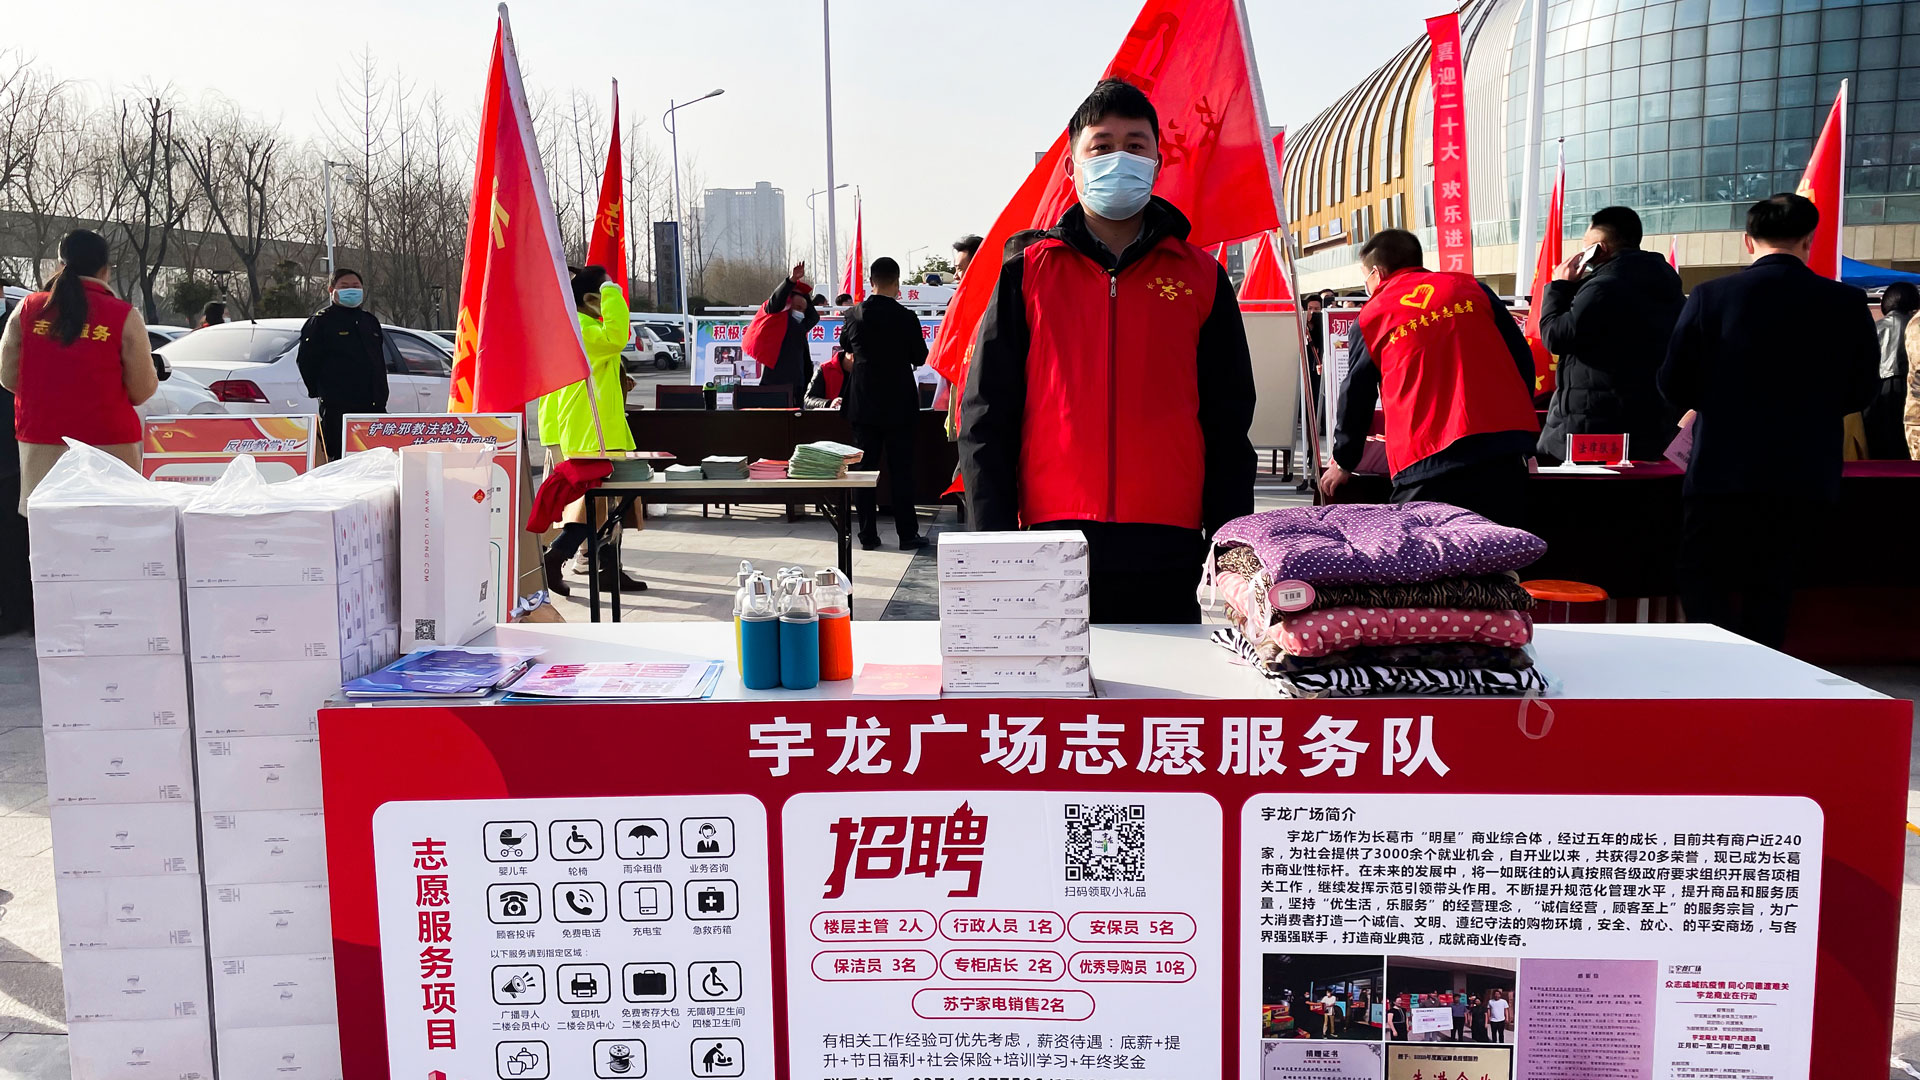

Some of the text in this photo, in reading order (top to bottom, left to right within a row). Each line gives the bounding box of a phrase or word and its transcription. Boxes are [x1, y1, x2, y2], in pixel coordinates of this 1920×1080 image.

[1436, 41, 1465, 272] 喜迎二十大 欢乐进万
[1389, 299, 1475, 345] 长葛市青年志愿者
[368, 422, 470, 436] 铲除邪教法轮功
[749, 714, 1451, 778] 宇龙广场志愿服务队
[1260, 806, 1357, 822] 宇龙广场简介
[823, 800, 988, 900] 招聘
[498, 866, 528, 877] 婴儿车
[568, 866, 588, 877] 轮椅
[622, 863, 663, 874] 雨伞租借
[689, 863, 729, 873] 业务咨询
[1065, 886, 1147, 898] 扫码领取小礼品
[632, 926, 662, 937] 充电宝
[692, 925, 732, 936] 急救药箱
[824, 918, 924, 934] 楼层主管 2人
[953, 918, 1053, 935] 行政人员 1名
[1089, 920, 1174, 936] 安保员 5名
[496, 929, 536, 940] 顾客投诉
[562, 928, 601, 939] 免费电话
[1260, 930, 1529, 947] 界强强联手，打造商业典范，成就商业传奇。
[411, 837, 458, 1051] 志愿服务项目
[834, 957, 916, 974] 保洁员 3名
[953, 957, 1053, 974] 专柜店长 2名
[1079, 959, 1185, 975] 优秀导购员 10名
[1696, 991, 1758, 1001] 宇龙商业在行动
[943, 996, 1065, 1013] 苏宁家电销售2名
[501, 1010, 540, 1020] 广播寻人
[571, 1009, 601, 1019] 复印机
[622, 1008, 680, 1018] 免费寄存大包
[687, 1006, 746, 1017] 无障碍卫生间
[492, 1020, 551, 1031] 二楼会员中心
[557, 1020, 616, 1031] 二楼会员中心
[622, 1020, 681, 1030] 二楼会员中心
[692, 1018, 741, 1029] 四楼卫生间
[823, 1032, 1181, 1051] 有相关工作经验可优先考虑，薪资待遇：底薪+提
[823, 1052, 1146, 1070] 升+节日福利+社会保险+培训学习+年终奖金
